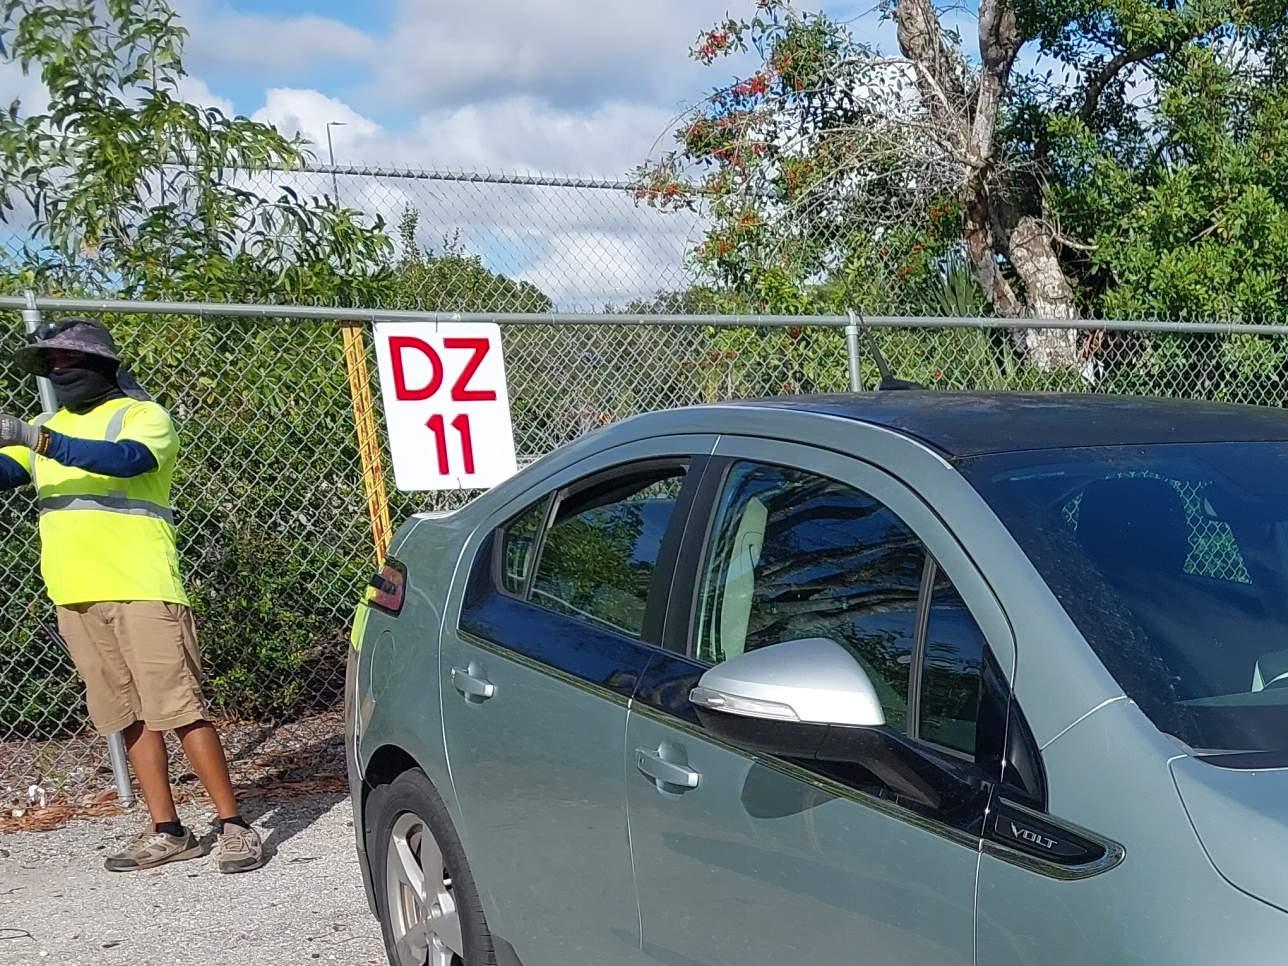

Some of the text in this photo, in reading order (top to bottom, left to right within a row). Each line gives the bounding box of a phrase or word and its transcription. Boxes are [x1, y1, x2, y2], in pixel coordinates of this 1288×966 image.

[388, 336, 497, 401] DZ
[425, 413, 475, 476] 11
[1011, 821, 1059, 849] VOLT
